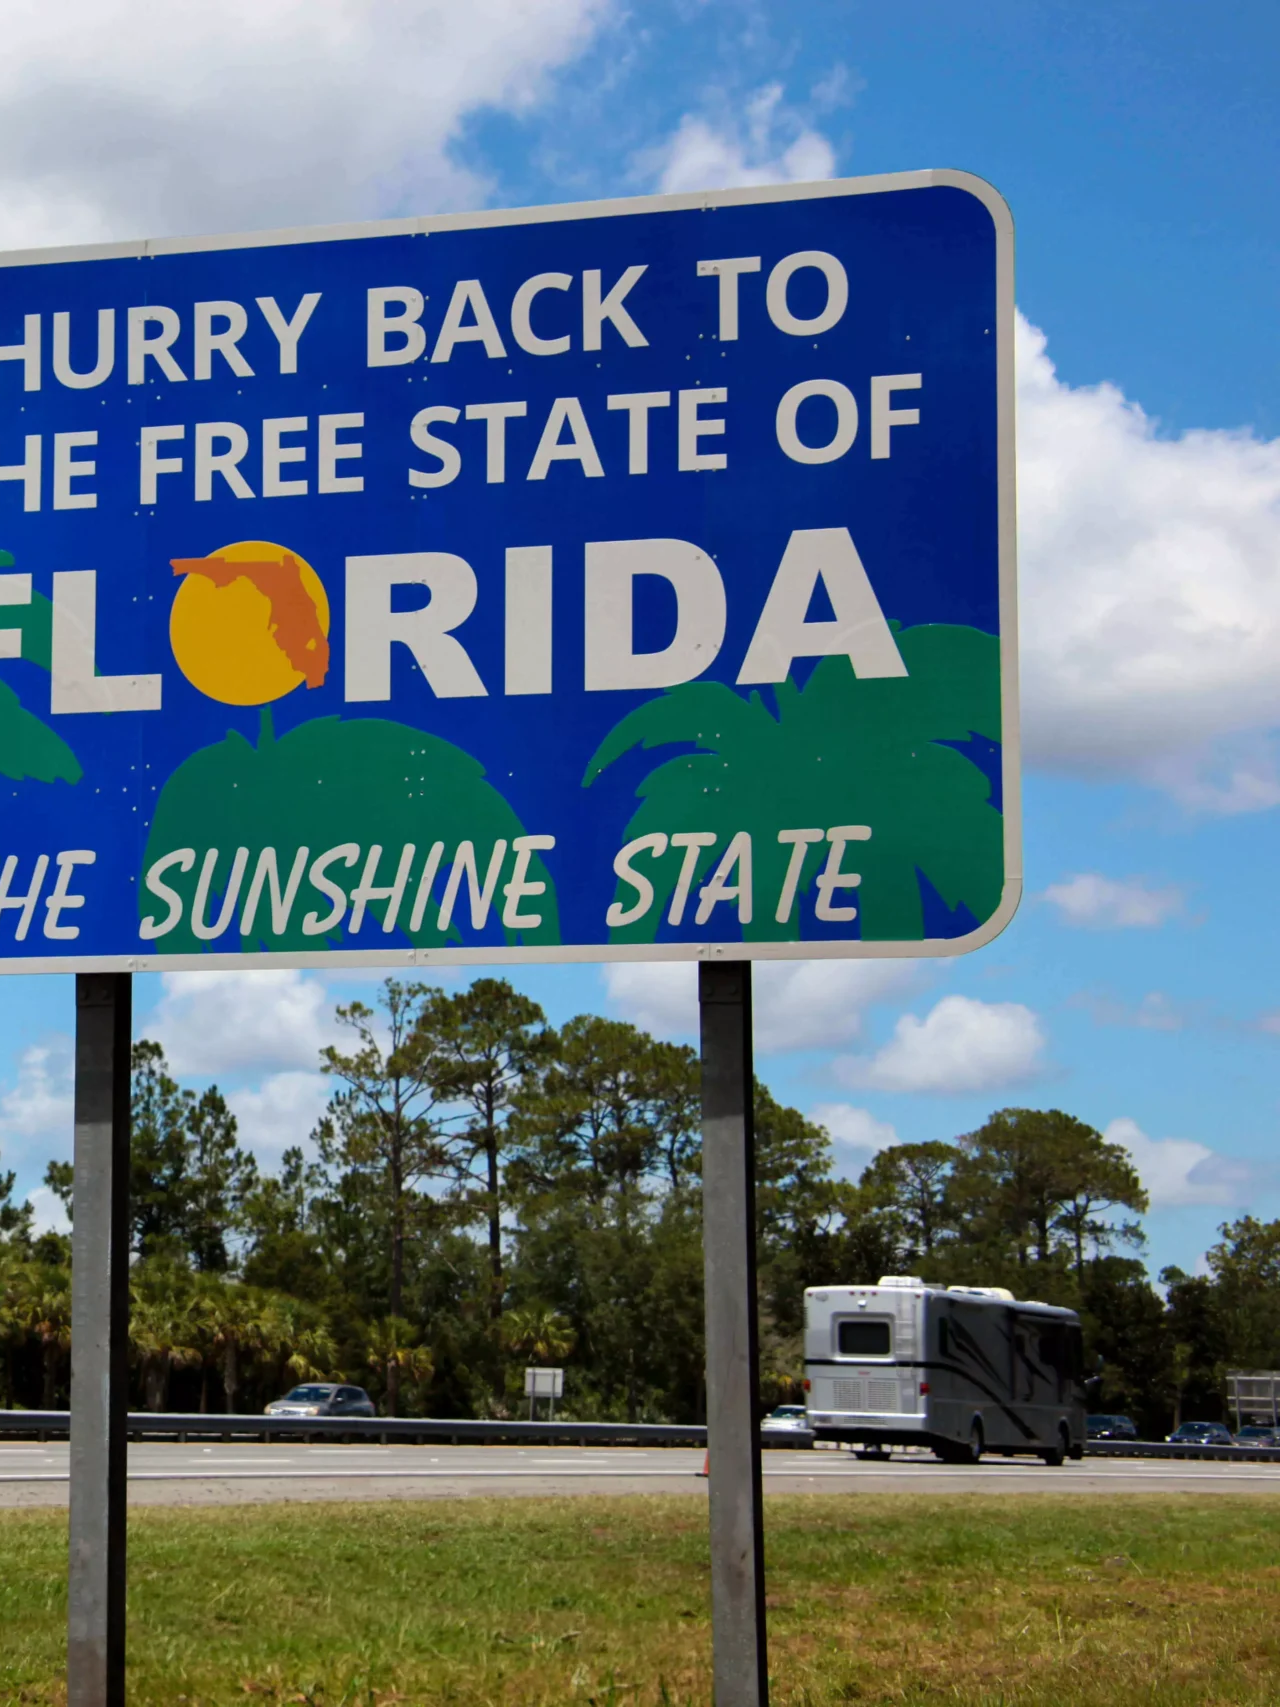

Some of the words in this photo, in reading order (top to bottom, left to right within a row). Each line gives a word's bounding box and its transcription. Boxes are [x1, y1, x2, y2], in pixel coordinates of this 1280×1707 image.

[368, 265, 649, 367] BACK
[697, 251, 848, 340] TO
[141, 413, 364, 504] FREE
[409, 388, 727, 488] STATE
[776, 373, 921, 464] OF
[140, 835, 555, 939] SUNSHINE
[606, 826, 871, 926] STATE
